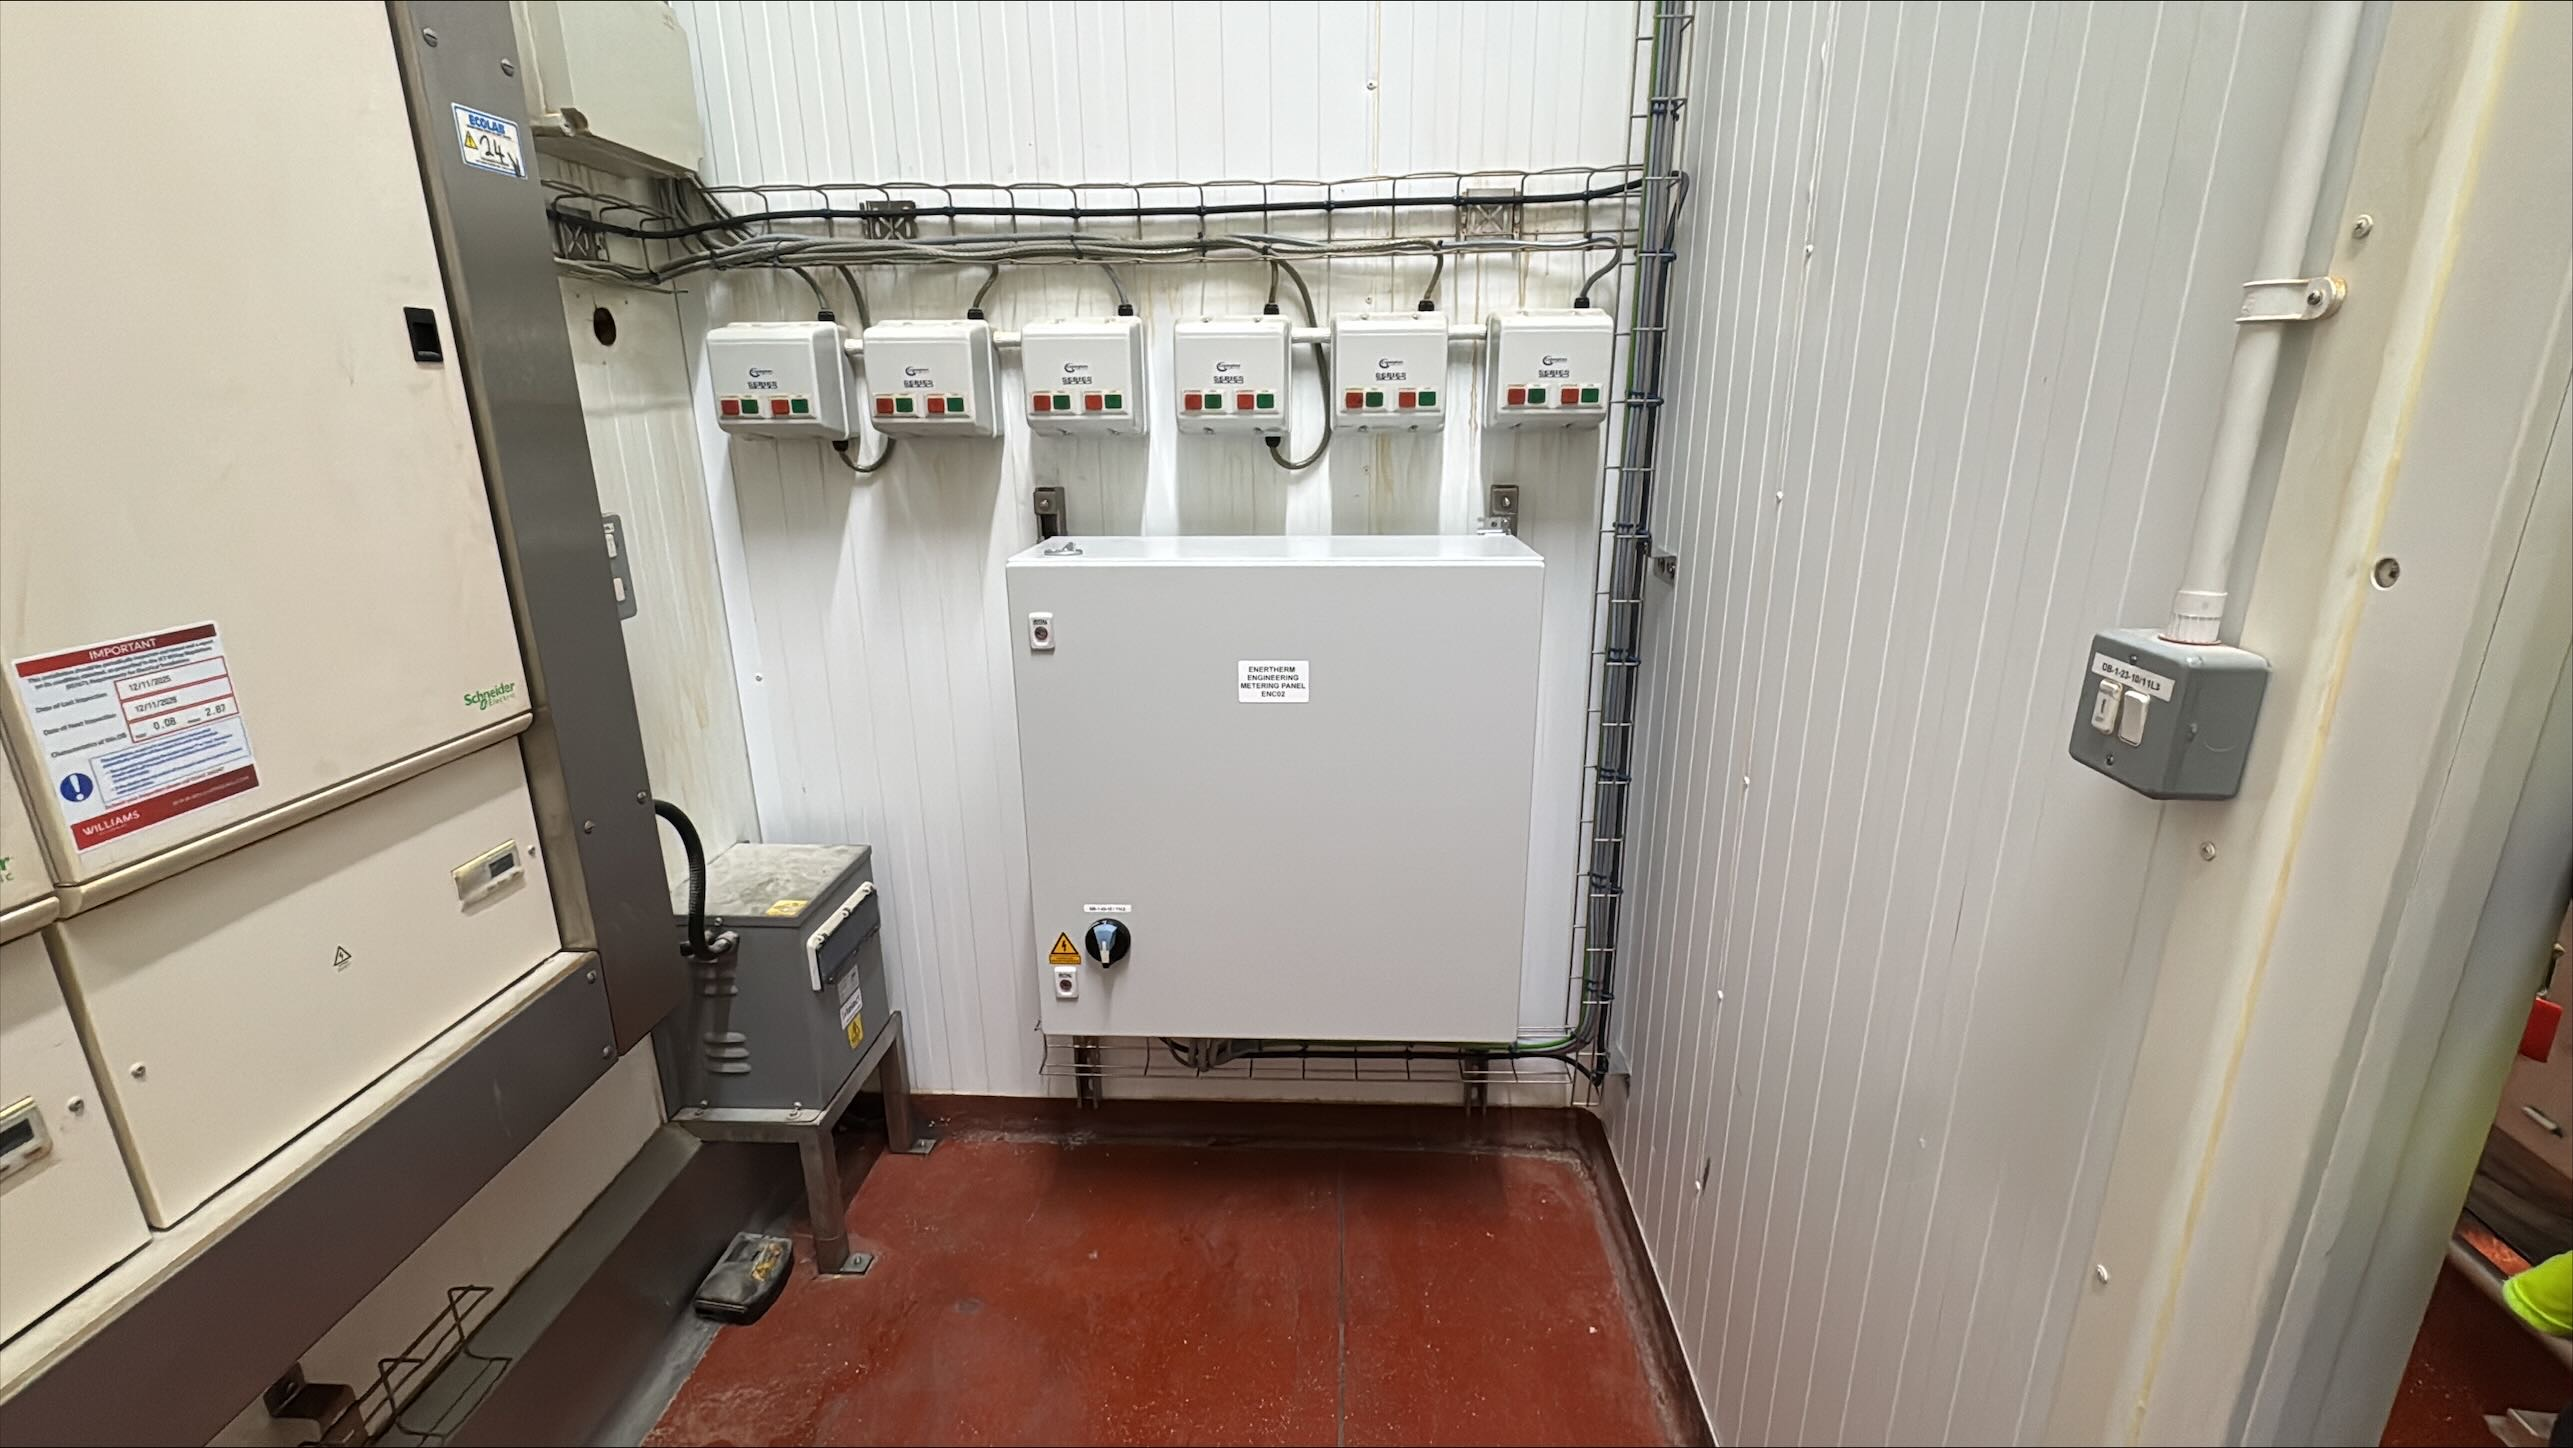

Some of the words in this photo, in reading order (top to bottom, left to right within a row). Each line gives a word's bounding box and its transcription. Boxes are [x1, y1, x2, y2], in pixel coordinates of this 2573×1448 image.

[89, 638, 158, 660] IMPORTANT
[463, 682, 516, 708] Schneider
[1261, 690, 1286, 698] ENC02
[152, 716, 177, 730] 0.08
[82, 809, 141, 836] WILLIAMS
